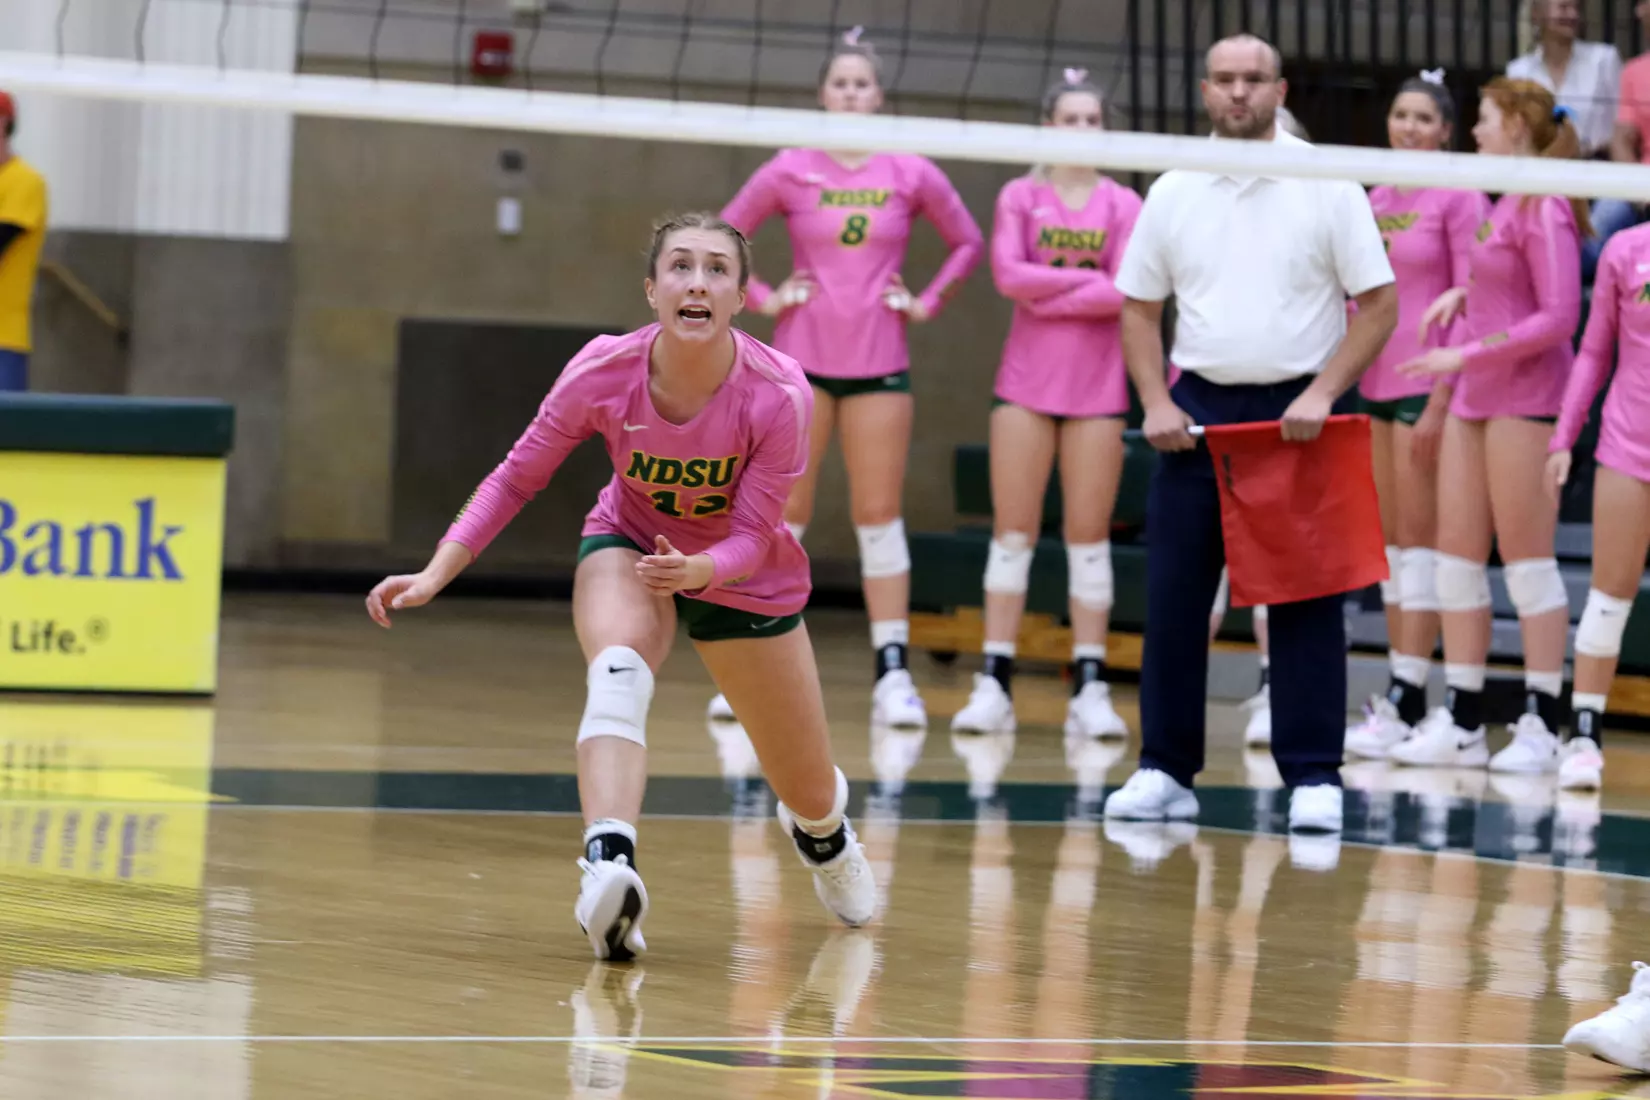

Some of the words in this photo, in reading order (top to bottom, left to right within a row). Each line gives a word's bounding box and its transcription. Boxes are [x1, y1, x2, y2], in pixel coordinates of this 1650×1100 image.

[818, 188, 889, 209] NDSU
[840, 213, 868, 246] 8
[1036, 226, 1106, 251] NDSU
[624, 449, 741, 488] NDSU
